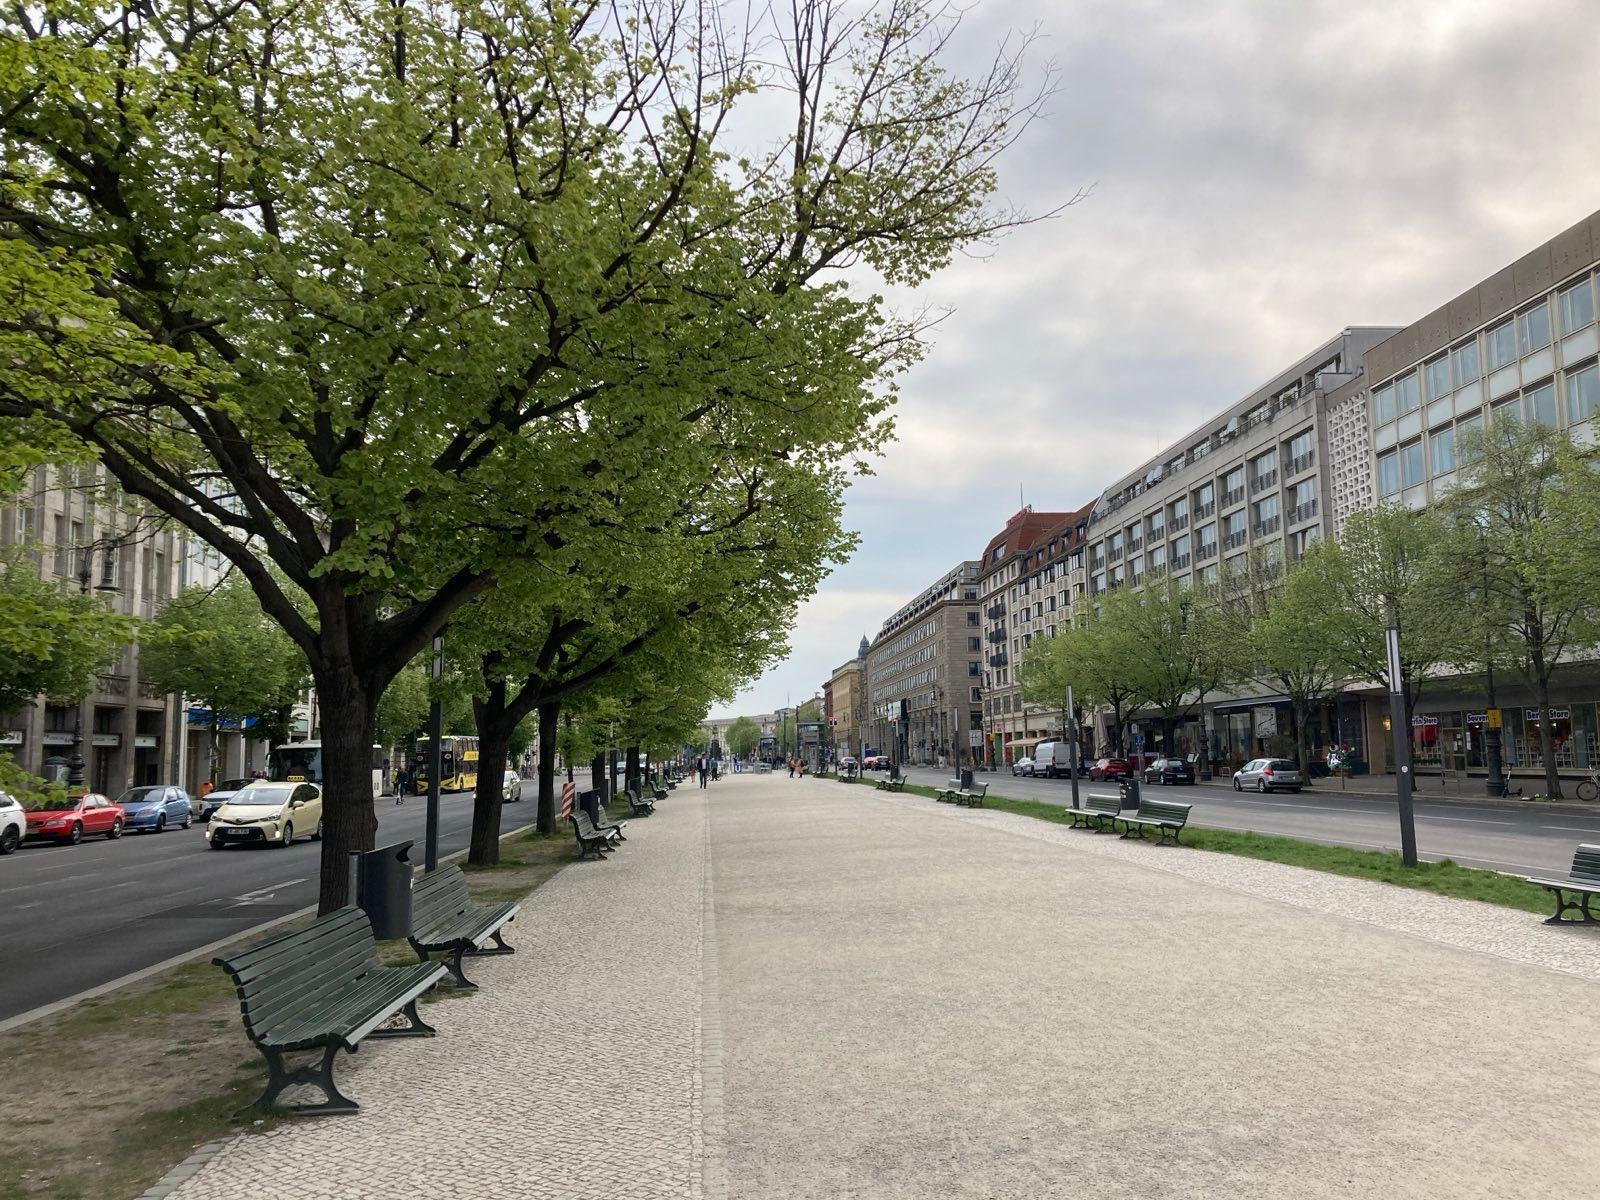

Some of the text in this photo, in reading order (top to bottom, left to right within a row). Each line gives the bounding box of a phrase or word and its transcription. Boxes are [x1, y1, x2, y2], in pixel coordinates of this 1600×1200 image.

[1549, 709, 1569, 719] Store
[1423, 716, 1438, 725] Store
[734, 764, 741, 773] U
